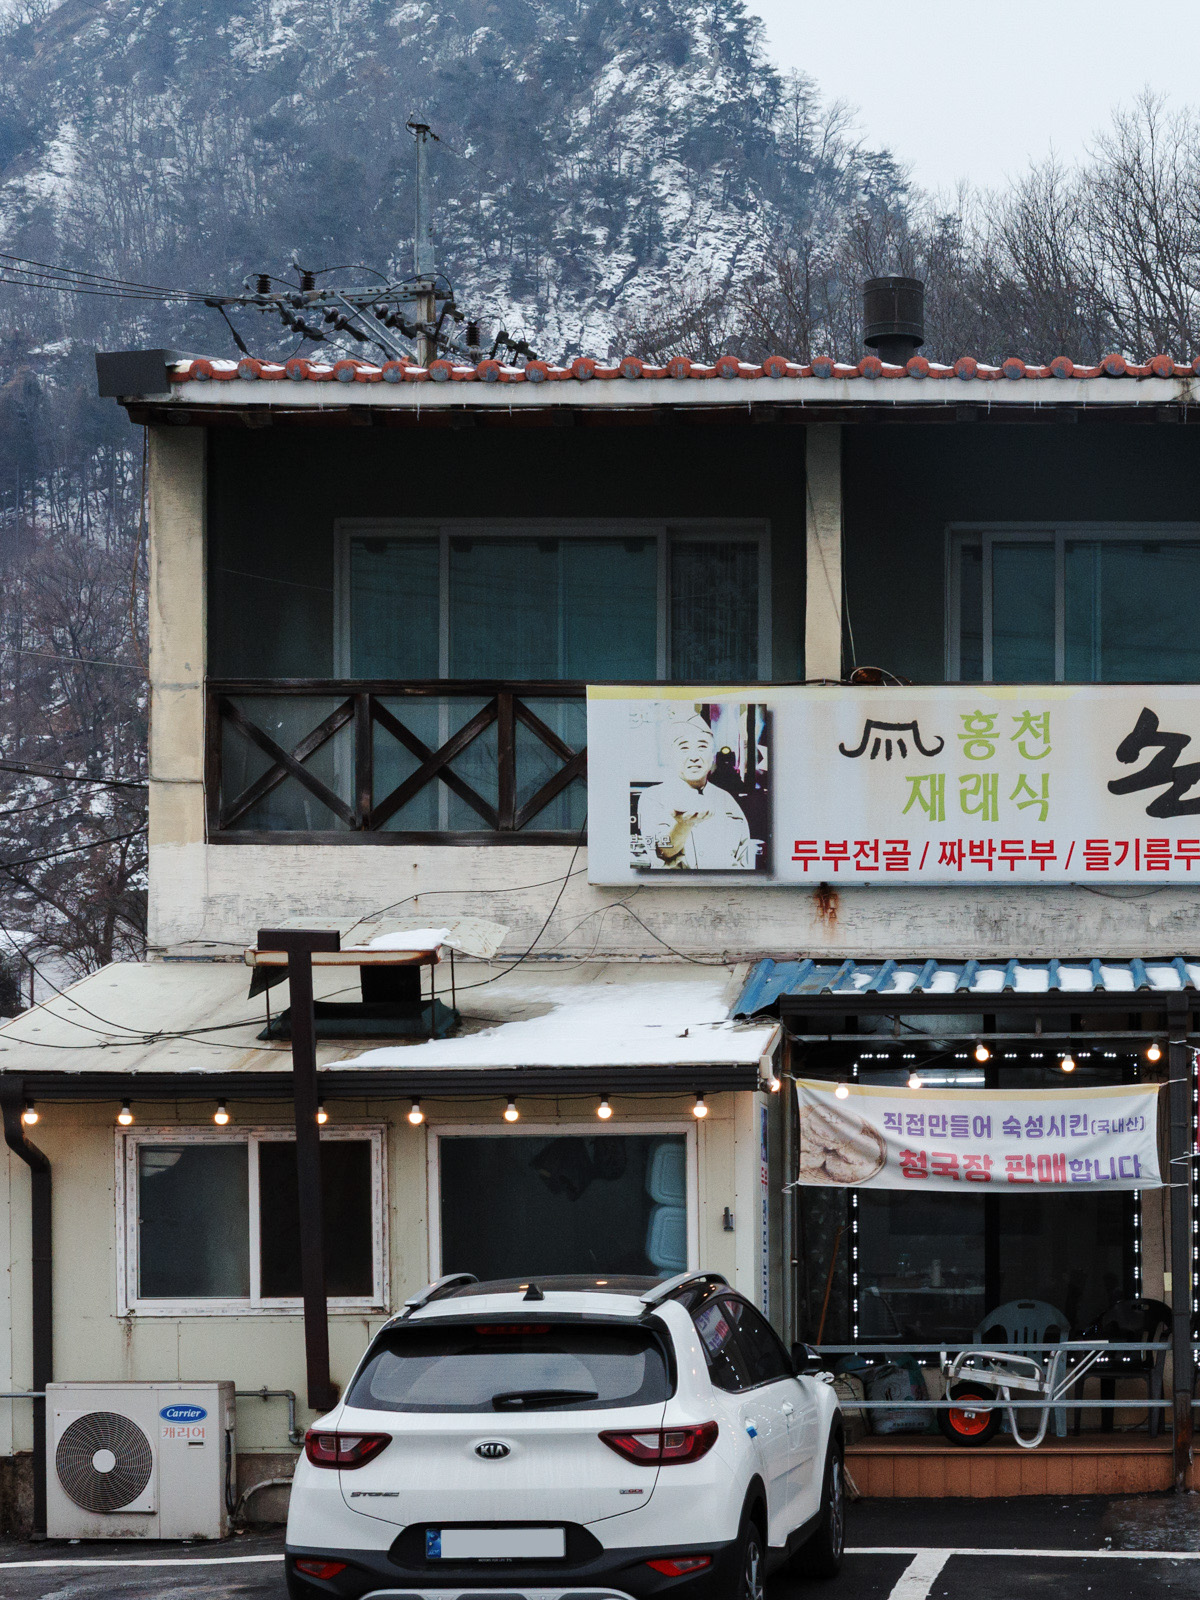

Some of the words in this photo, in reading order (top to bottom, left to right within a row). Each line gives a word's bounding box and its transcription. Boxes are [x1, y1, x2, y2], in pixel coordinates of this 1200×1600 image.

[957, 709, 1052, 761] 홍천
[902, 772, 1050, 822] 재래식
[791, 838, 912, 872] 두부전골
[938, 838, 1057, 872] 짜박두부
[883, 1112, 992, 1139] 직접만들어
[899, 1148, 994, 1182] 청국장
[1004, 1152, 1142, 1184] 판매합니다
[166, 1408, 202, 1418] Carrier
[162, 1426, 206, 1439] 캐리어
[480, 1444, 505, 1456] KIA
